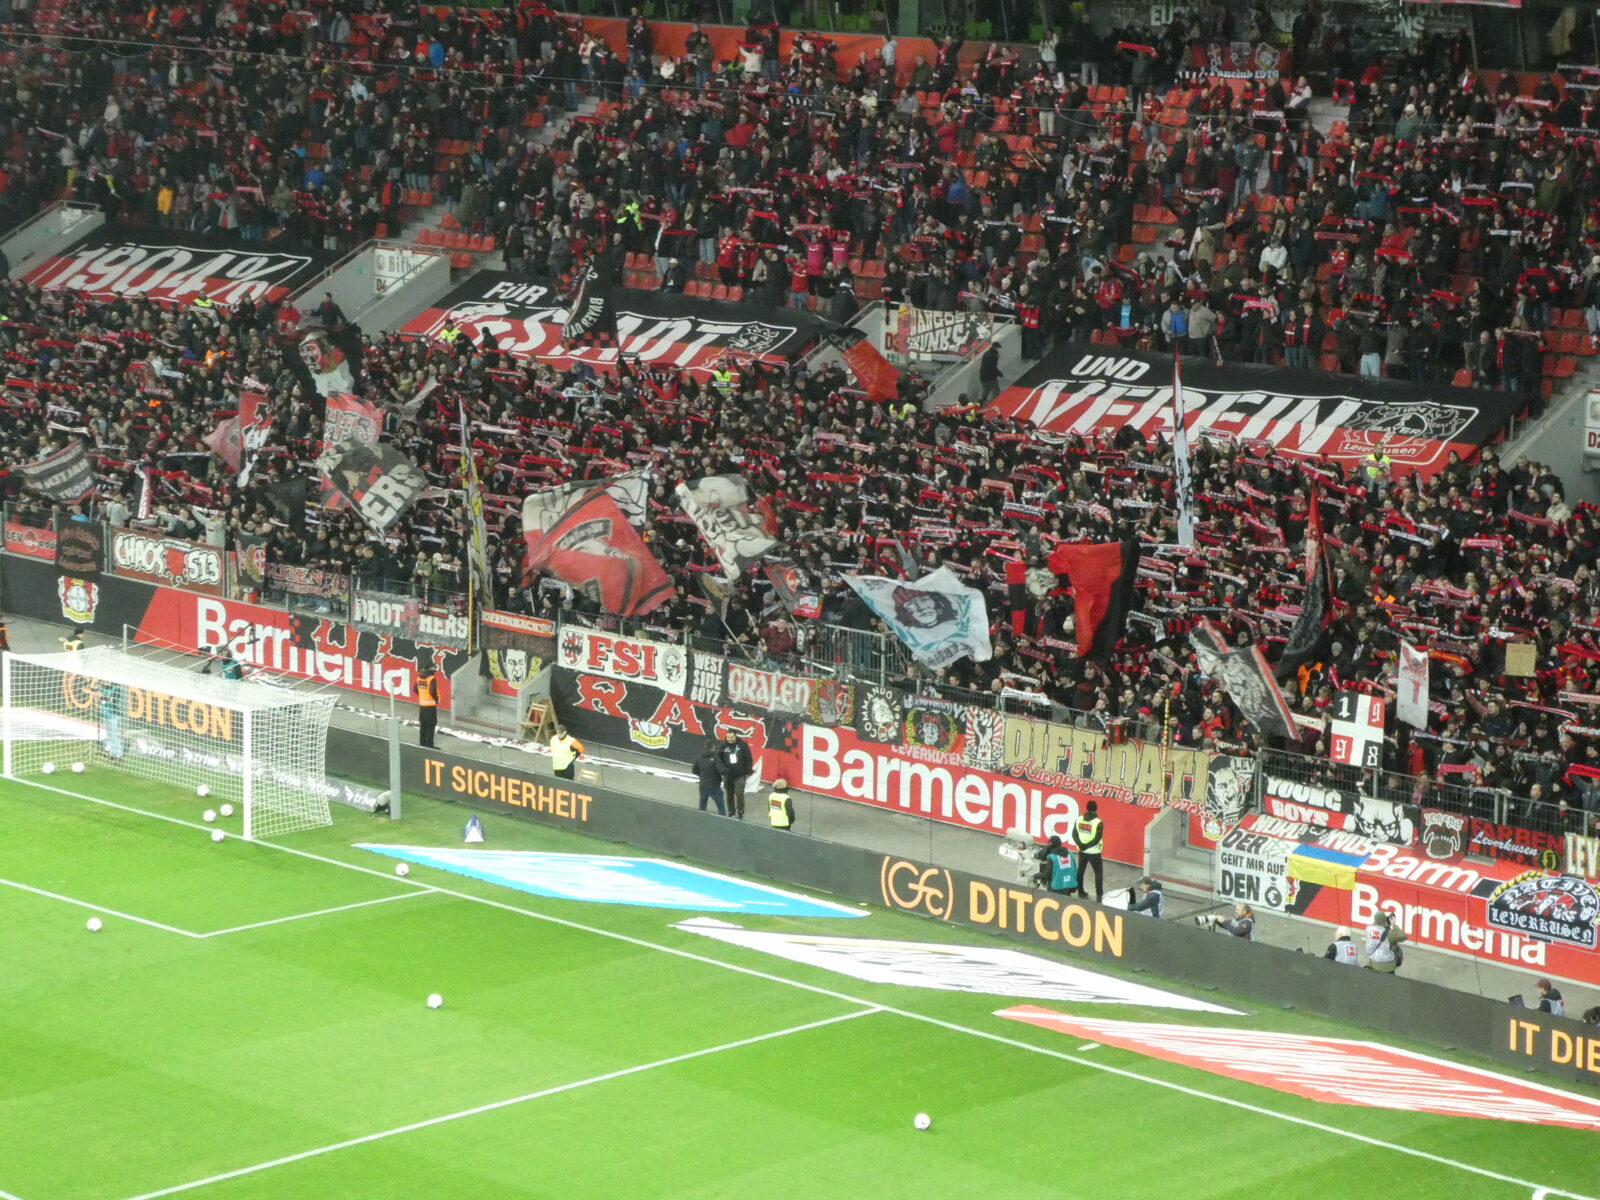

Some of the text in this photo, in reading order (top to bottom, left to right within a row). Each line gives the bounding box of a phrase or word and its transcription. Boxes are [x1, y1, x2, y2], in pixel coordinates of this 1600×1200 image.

[483, 281, 548, 305] FÜR
[1071, 355, 1150, 381] UND
[1029, 381, 1363, 454] VEREIN
[1344, 442, 1417, 455] Leverusen
[186, 549, 221, 584] 513
[586, 635, 659, 681] FSI
[694, 652, 724, 669] WEST
[693, 670, 722, 691] SIDE
[126, 685, 233, 742] DITCON
[1338, 696, 1351, 718] 1
[1334, 738, 1379, 766] 9 8
[424, 758, 593, 822] IT SICHERHEIT
[802, 724, 1081, 848] Barmenia
[1267, 775, 1342, 812] YOUNG
[1271, 800, 1329, 827] BOYS
[1221, 828, 1269, 855] DER
[1471, 830, 1538, 856] Leverkusen
[1221, 853, 1286, 877] GEHT MIR AUF
[1356, 843, 1482, 893] Barm
[1221, 869, 1261, 901] DEN
[969, 881, 1123, 958] DITCON
[1351, 883, 1546, 966] Barmenia
[1491, 907, 1592, 943] LEVERKUSEN
[1509, 1018, 1540, 1056] IT
